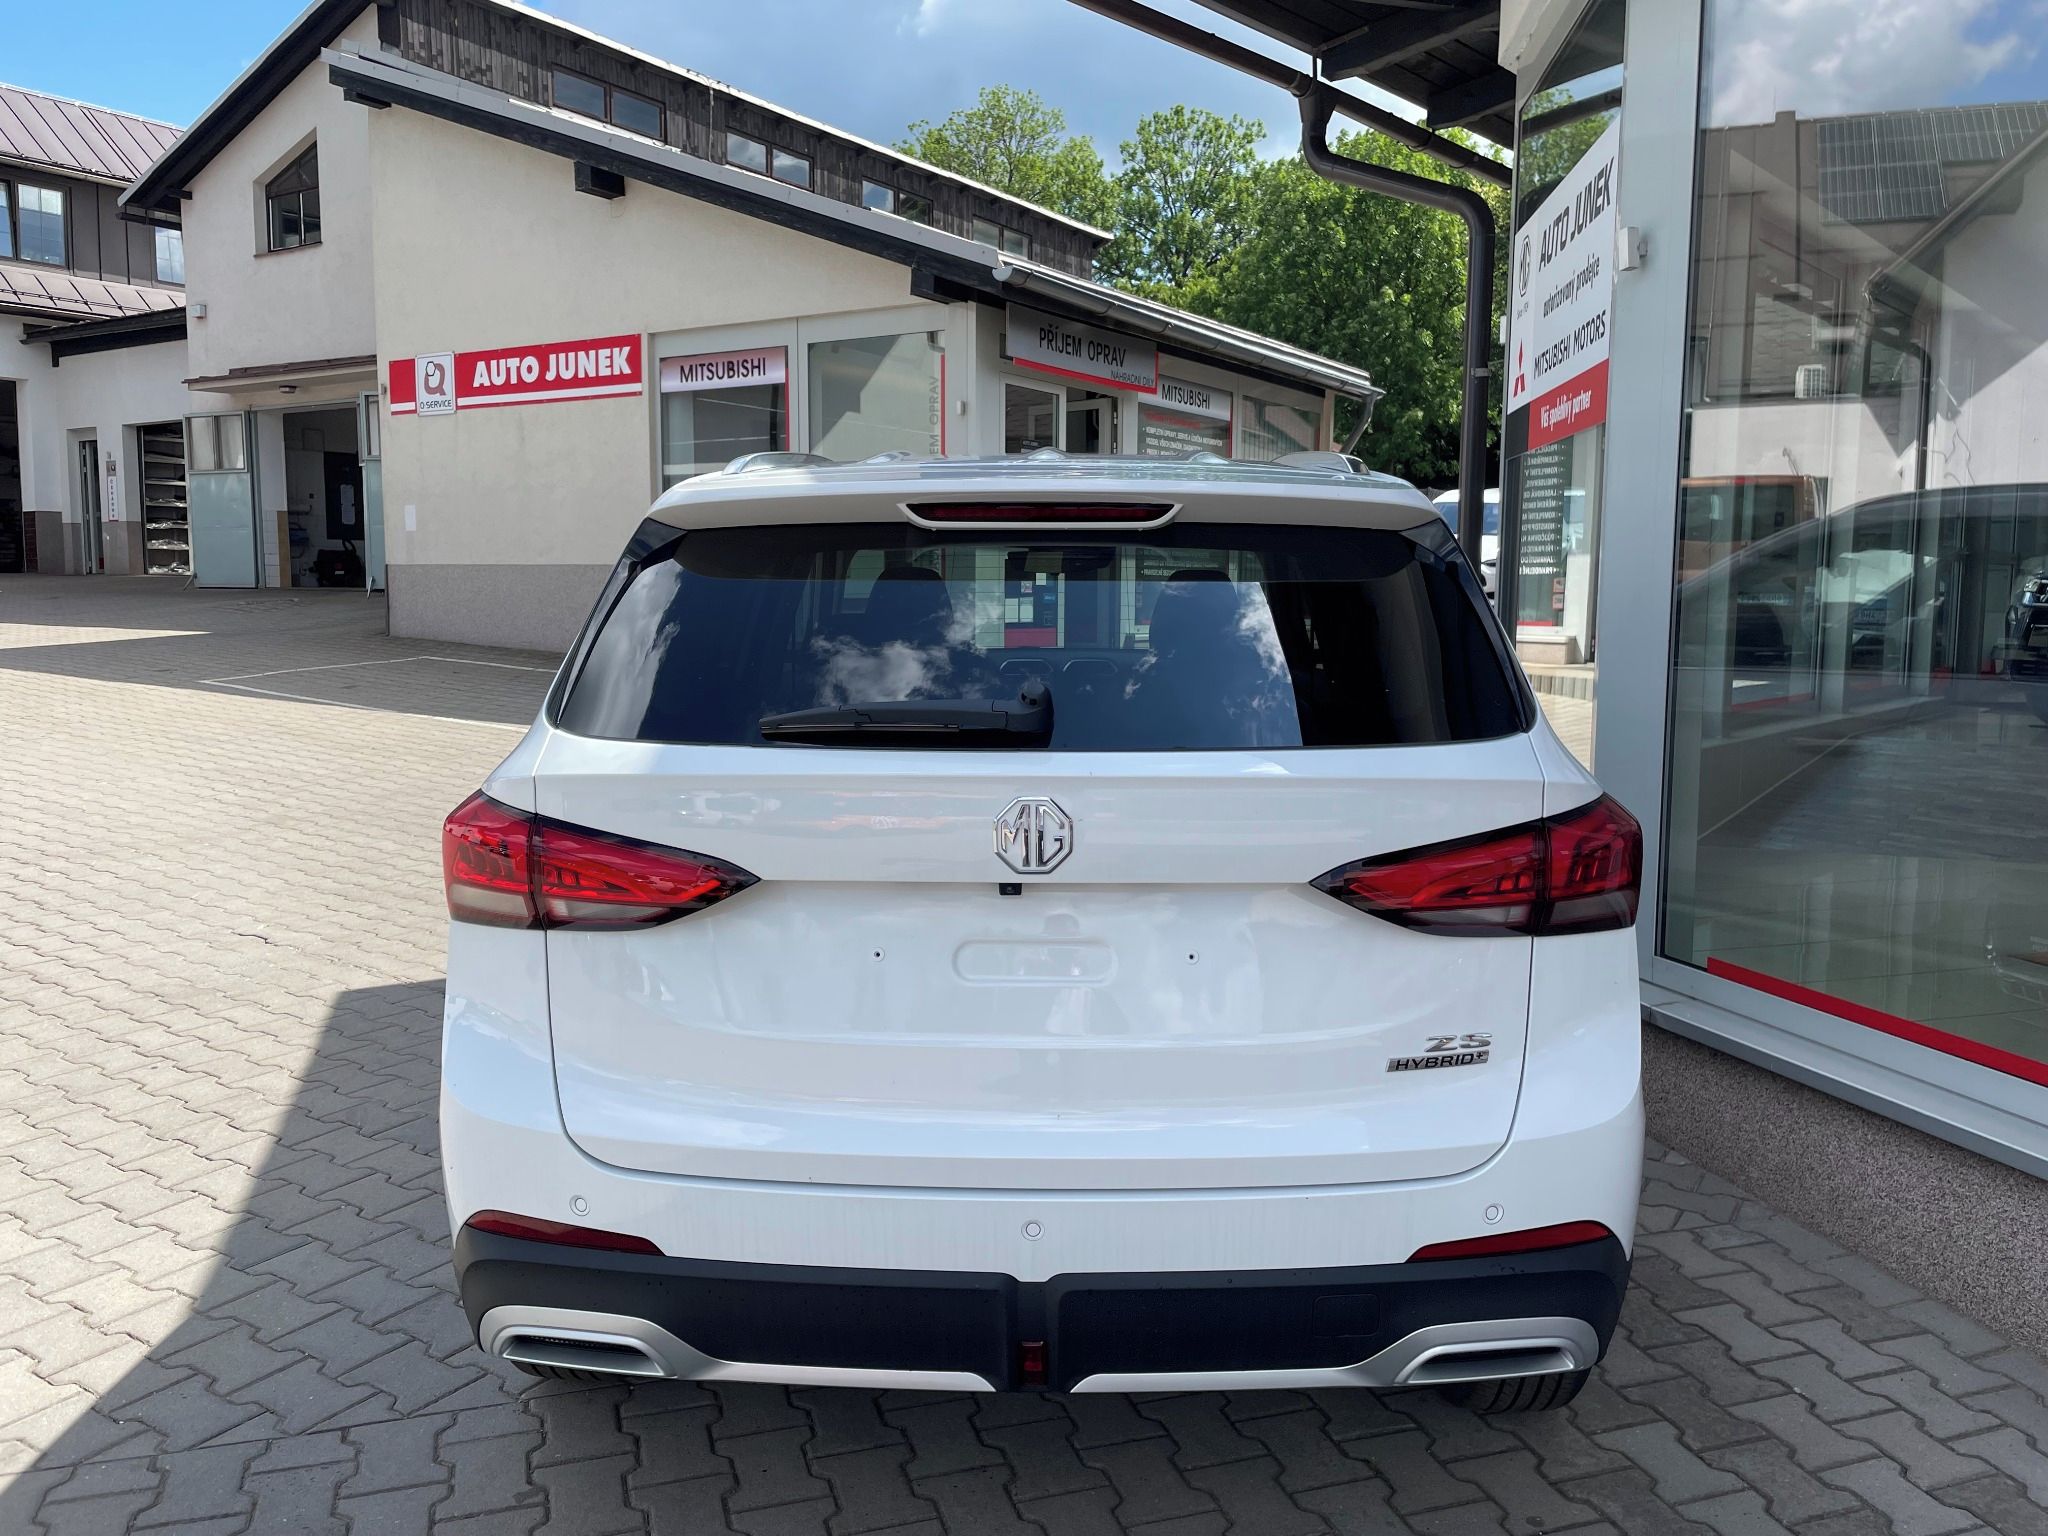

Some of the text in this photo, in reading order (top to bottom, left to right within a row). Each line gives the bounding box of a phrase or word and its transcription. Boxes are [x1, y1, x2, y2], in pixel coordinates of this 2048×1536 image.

[1538, 156, 1615, 272] AUTO JUNEK
[1575, 252, 1600, 301] prodejce
[1039, 323, 1126, 368] PŘÍJEM OPRAV
[1533, 309, 1607, 379] MITSUBISHI MOTORS
[472, 346, 632, 388] AUTO JUNEK
[680, 357, 767, 383] MITSUBISHI
[929, 375, 939, 425] OPRAV
[1161, 383, 1210, 410] MITSUBISHI
[1000, 804, 1064, 867] MG
[1395, 1052, 1484, 1071] HYBRID+
[1424, 1032, 1493, 1052] ZS
